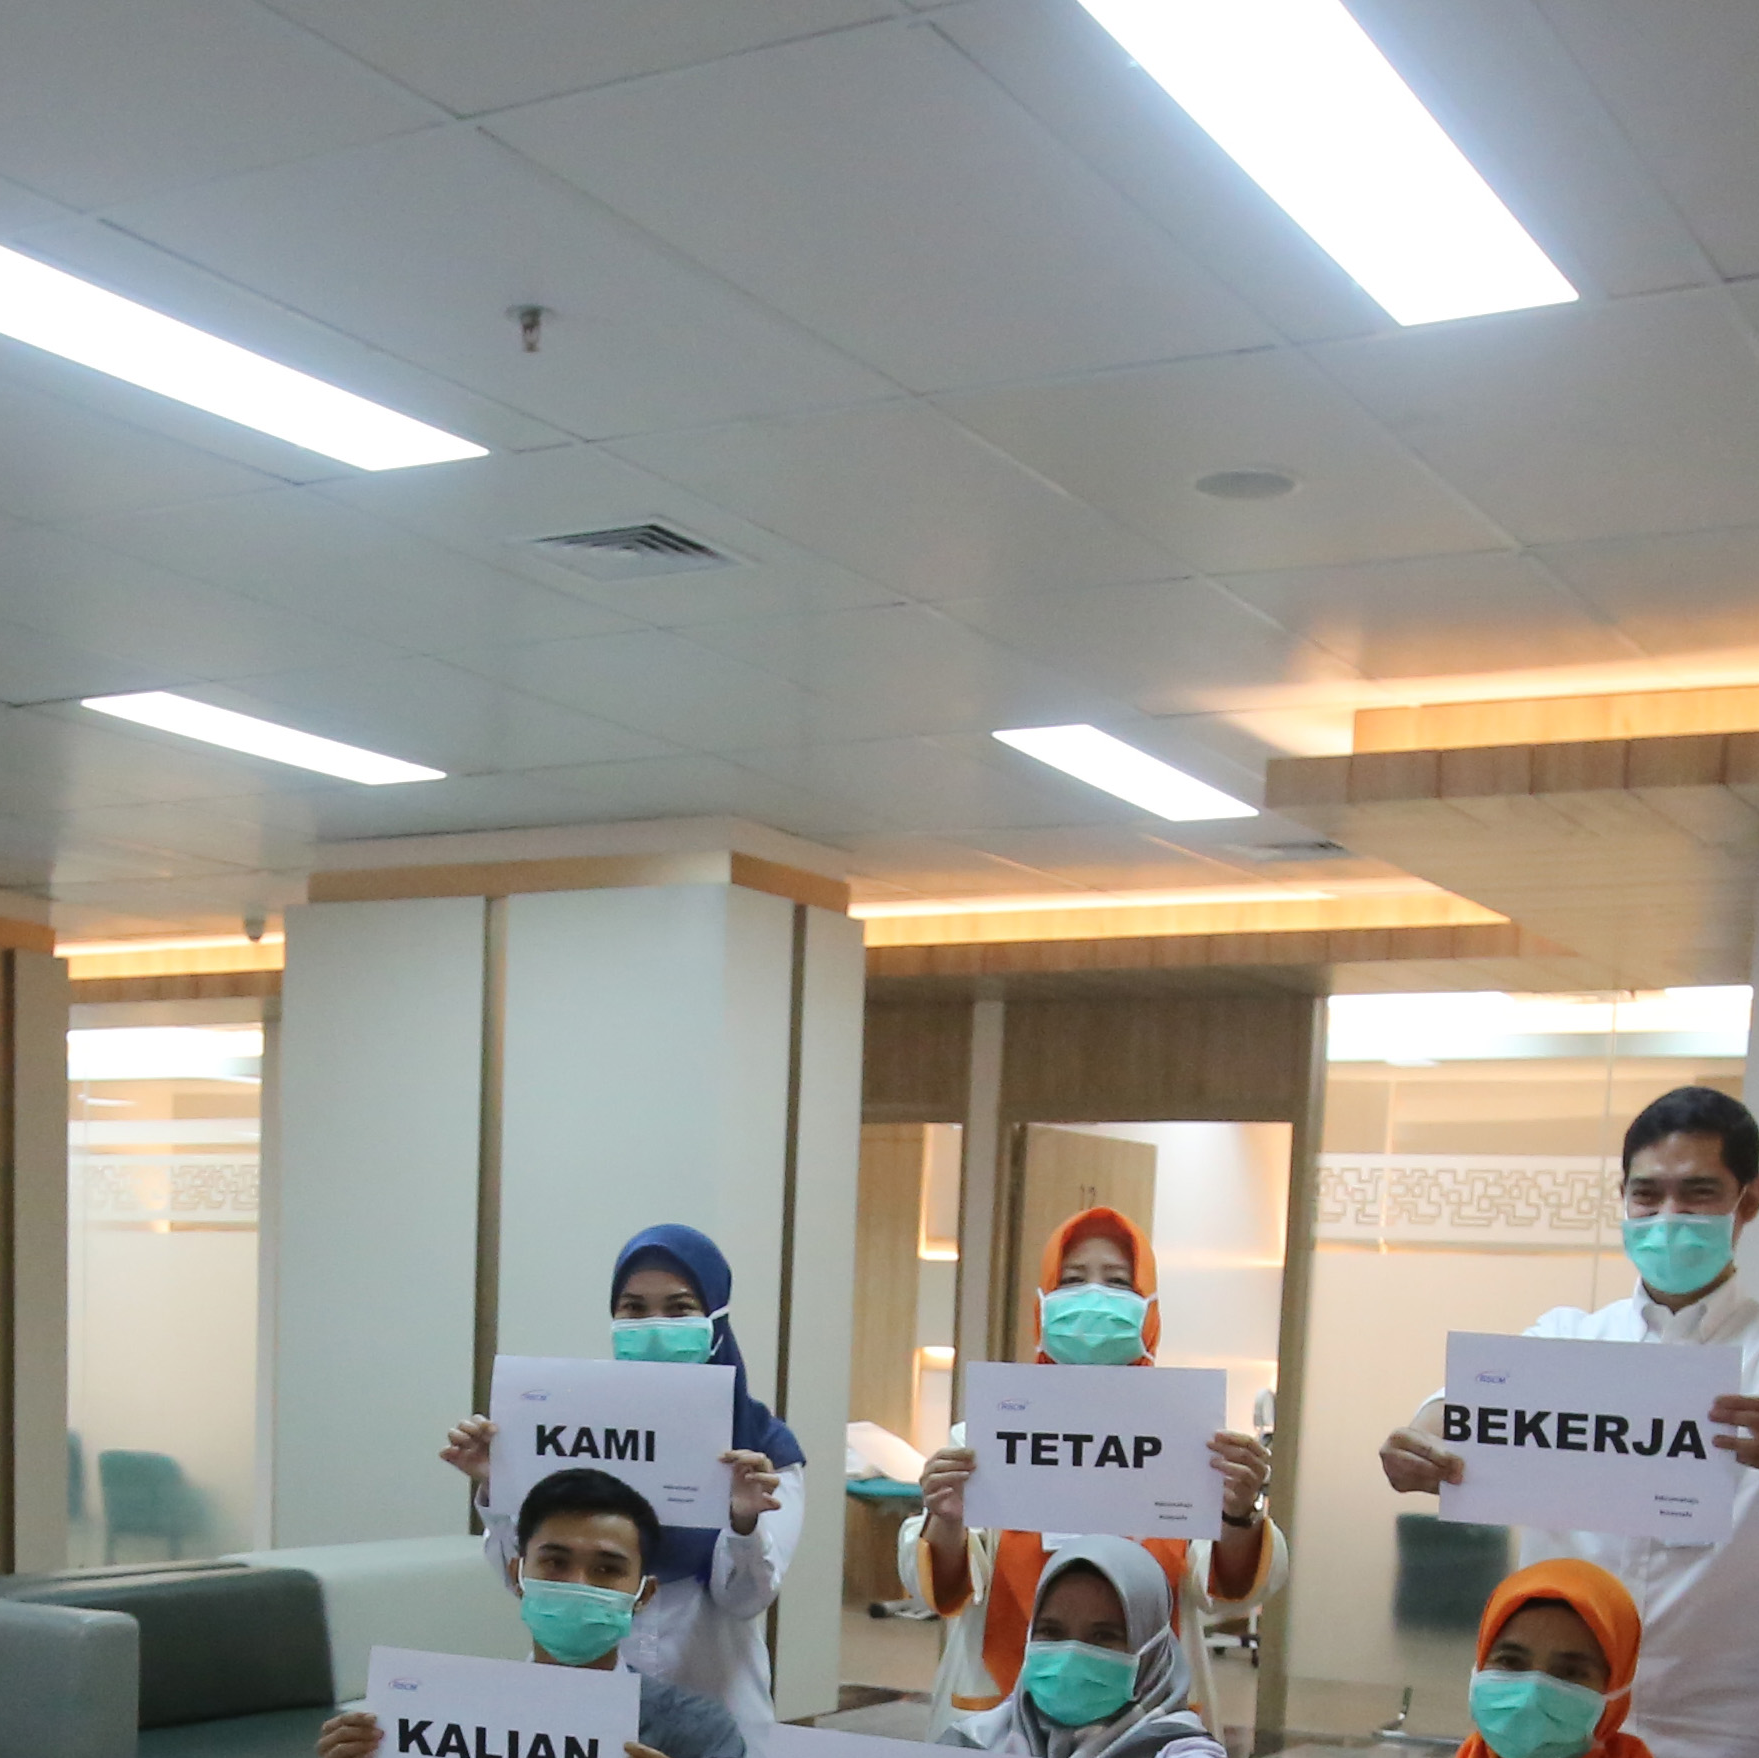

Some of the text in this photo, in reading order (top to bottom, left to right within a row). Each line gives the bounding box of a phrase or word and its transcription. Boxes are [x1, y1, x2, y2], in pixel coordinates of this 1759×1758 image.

[536, 1424, 656, 1462] KAMI
[996, 1431, 1162, 1469] TETAP
[1443, 1404, 1707, 1460] BEKERJA
